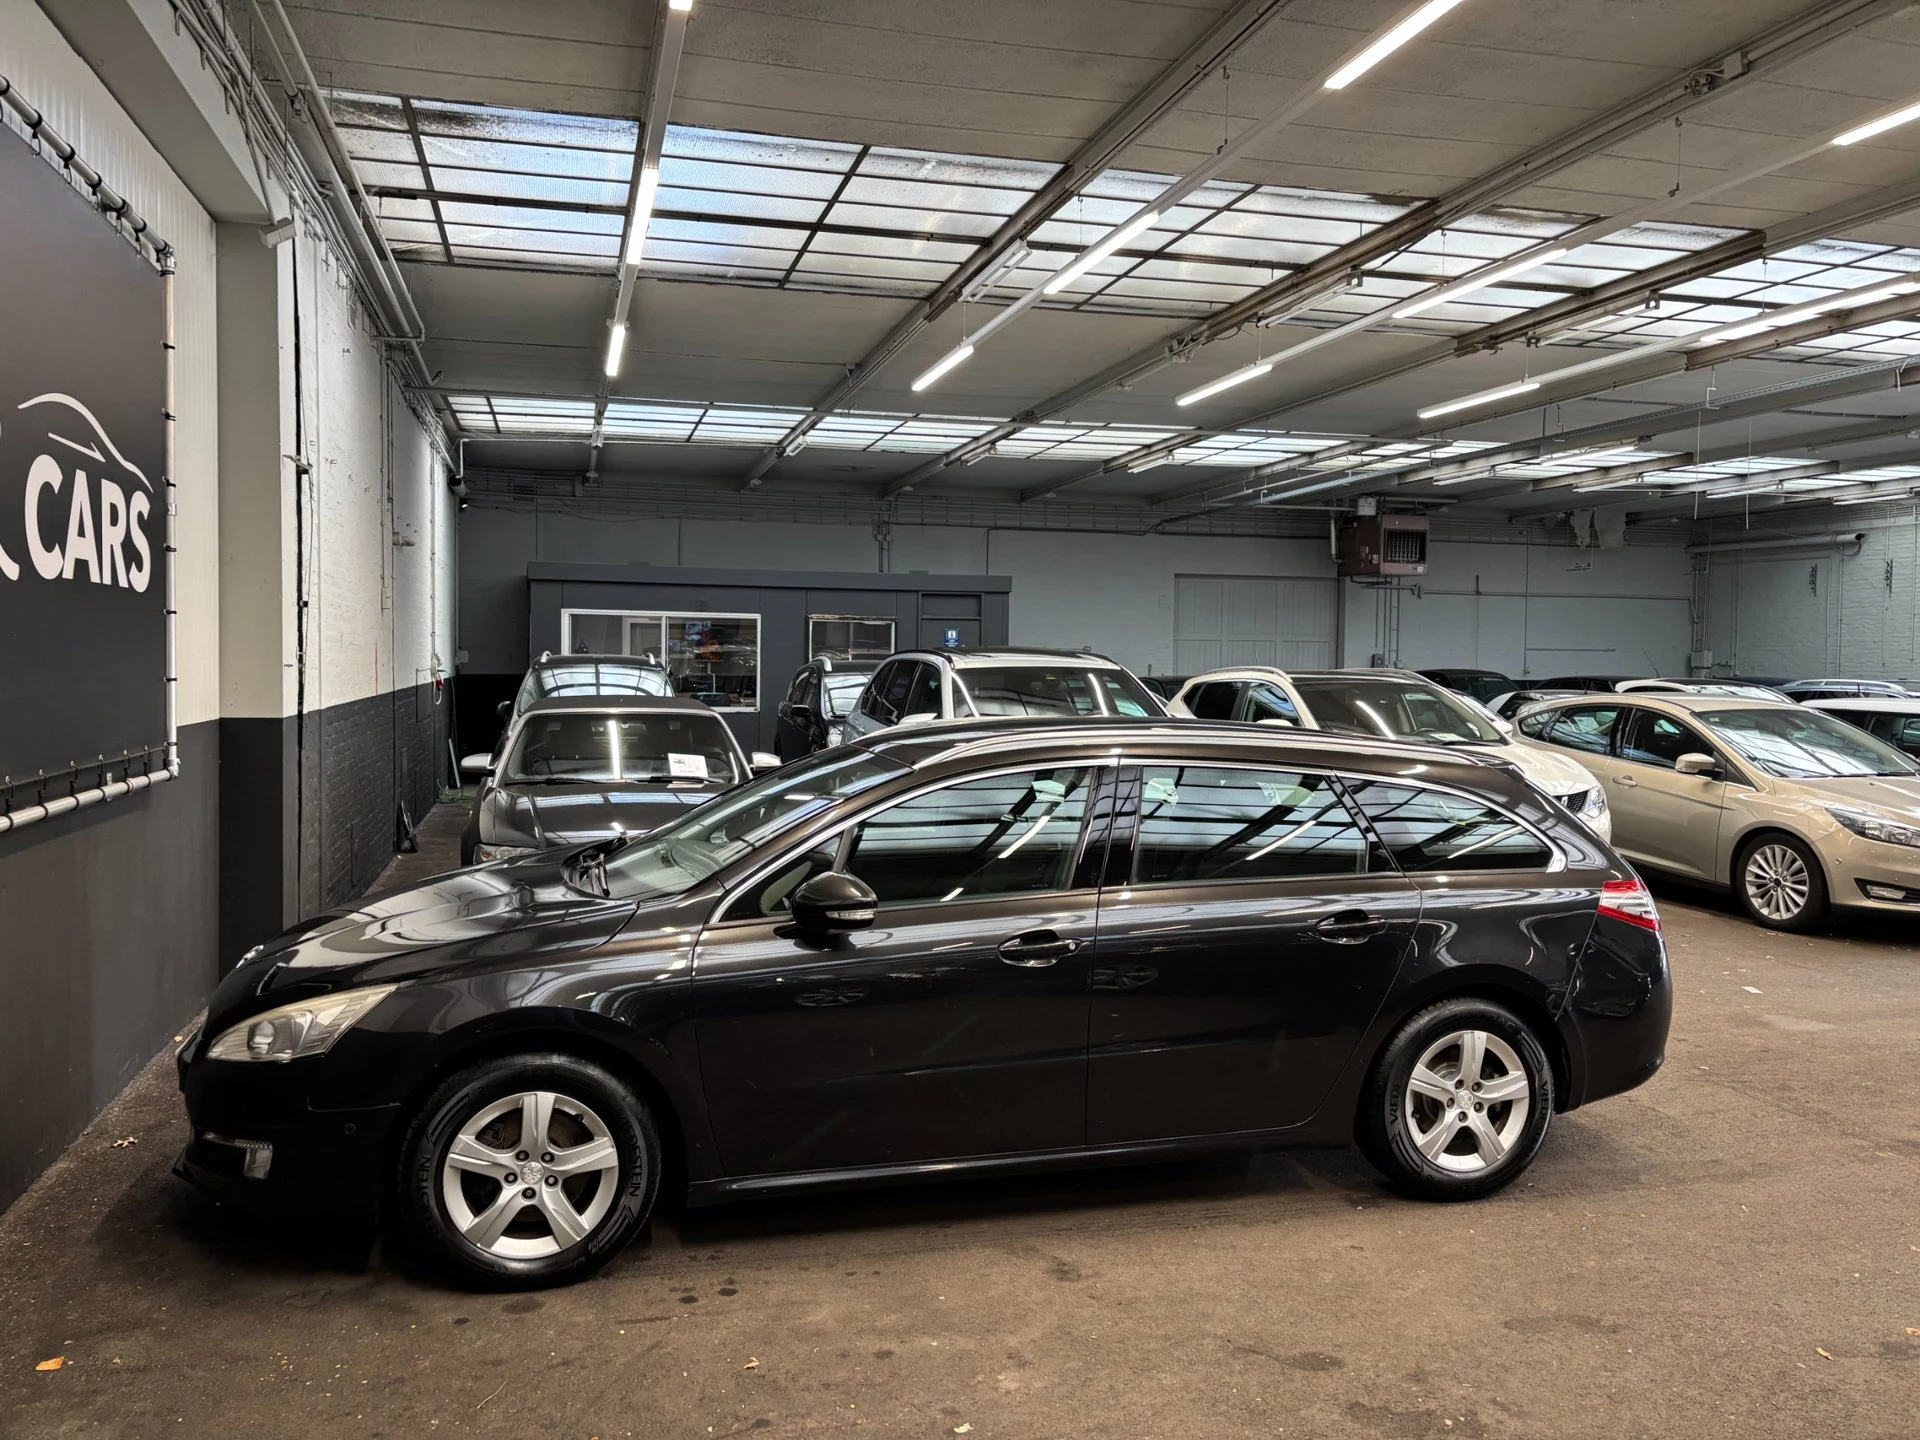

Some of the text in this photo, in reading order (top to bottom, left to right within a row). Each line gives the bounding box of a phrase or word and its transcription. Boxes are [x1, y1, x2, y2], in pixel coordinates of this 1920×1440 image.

[24, 453, 151, 594] CARS
[415, 1155, 437, 1234] EDESTEIN
[618, 1113, 643, 1197] REDESTEIN
